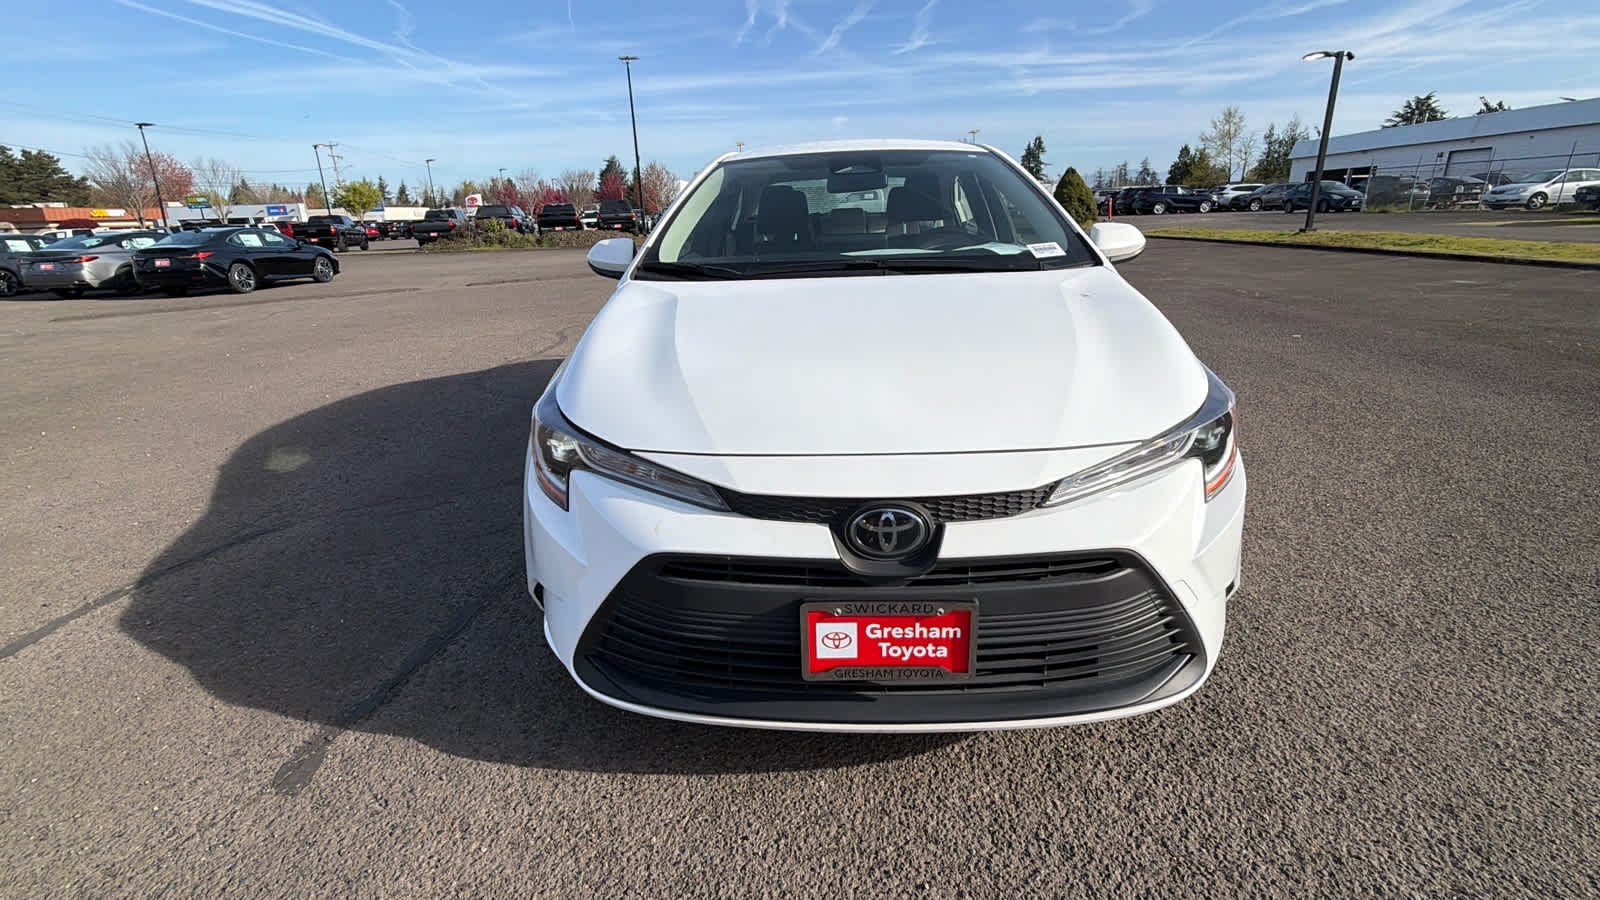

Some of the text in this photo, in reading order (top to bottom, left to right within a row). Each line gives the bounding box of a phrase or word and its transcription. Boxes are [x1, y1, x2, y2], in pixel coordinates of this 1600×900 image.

[844, 603, 934, 614] SWICKARD
[865, 623, 961, 639] Gresham
[878, 642, 948, 661] Toyota
[834, 668, 944, 679] GRESHAM TOYOTA
